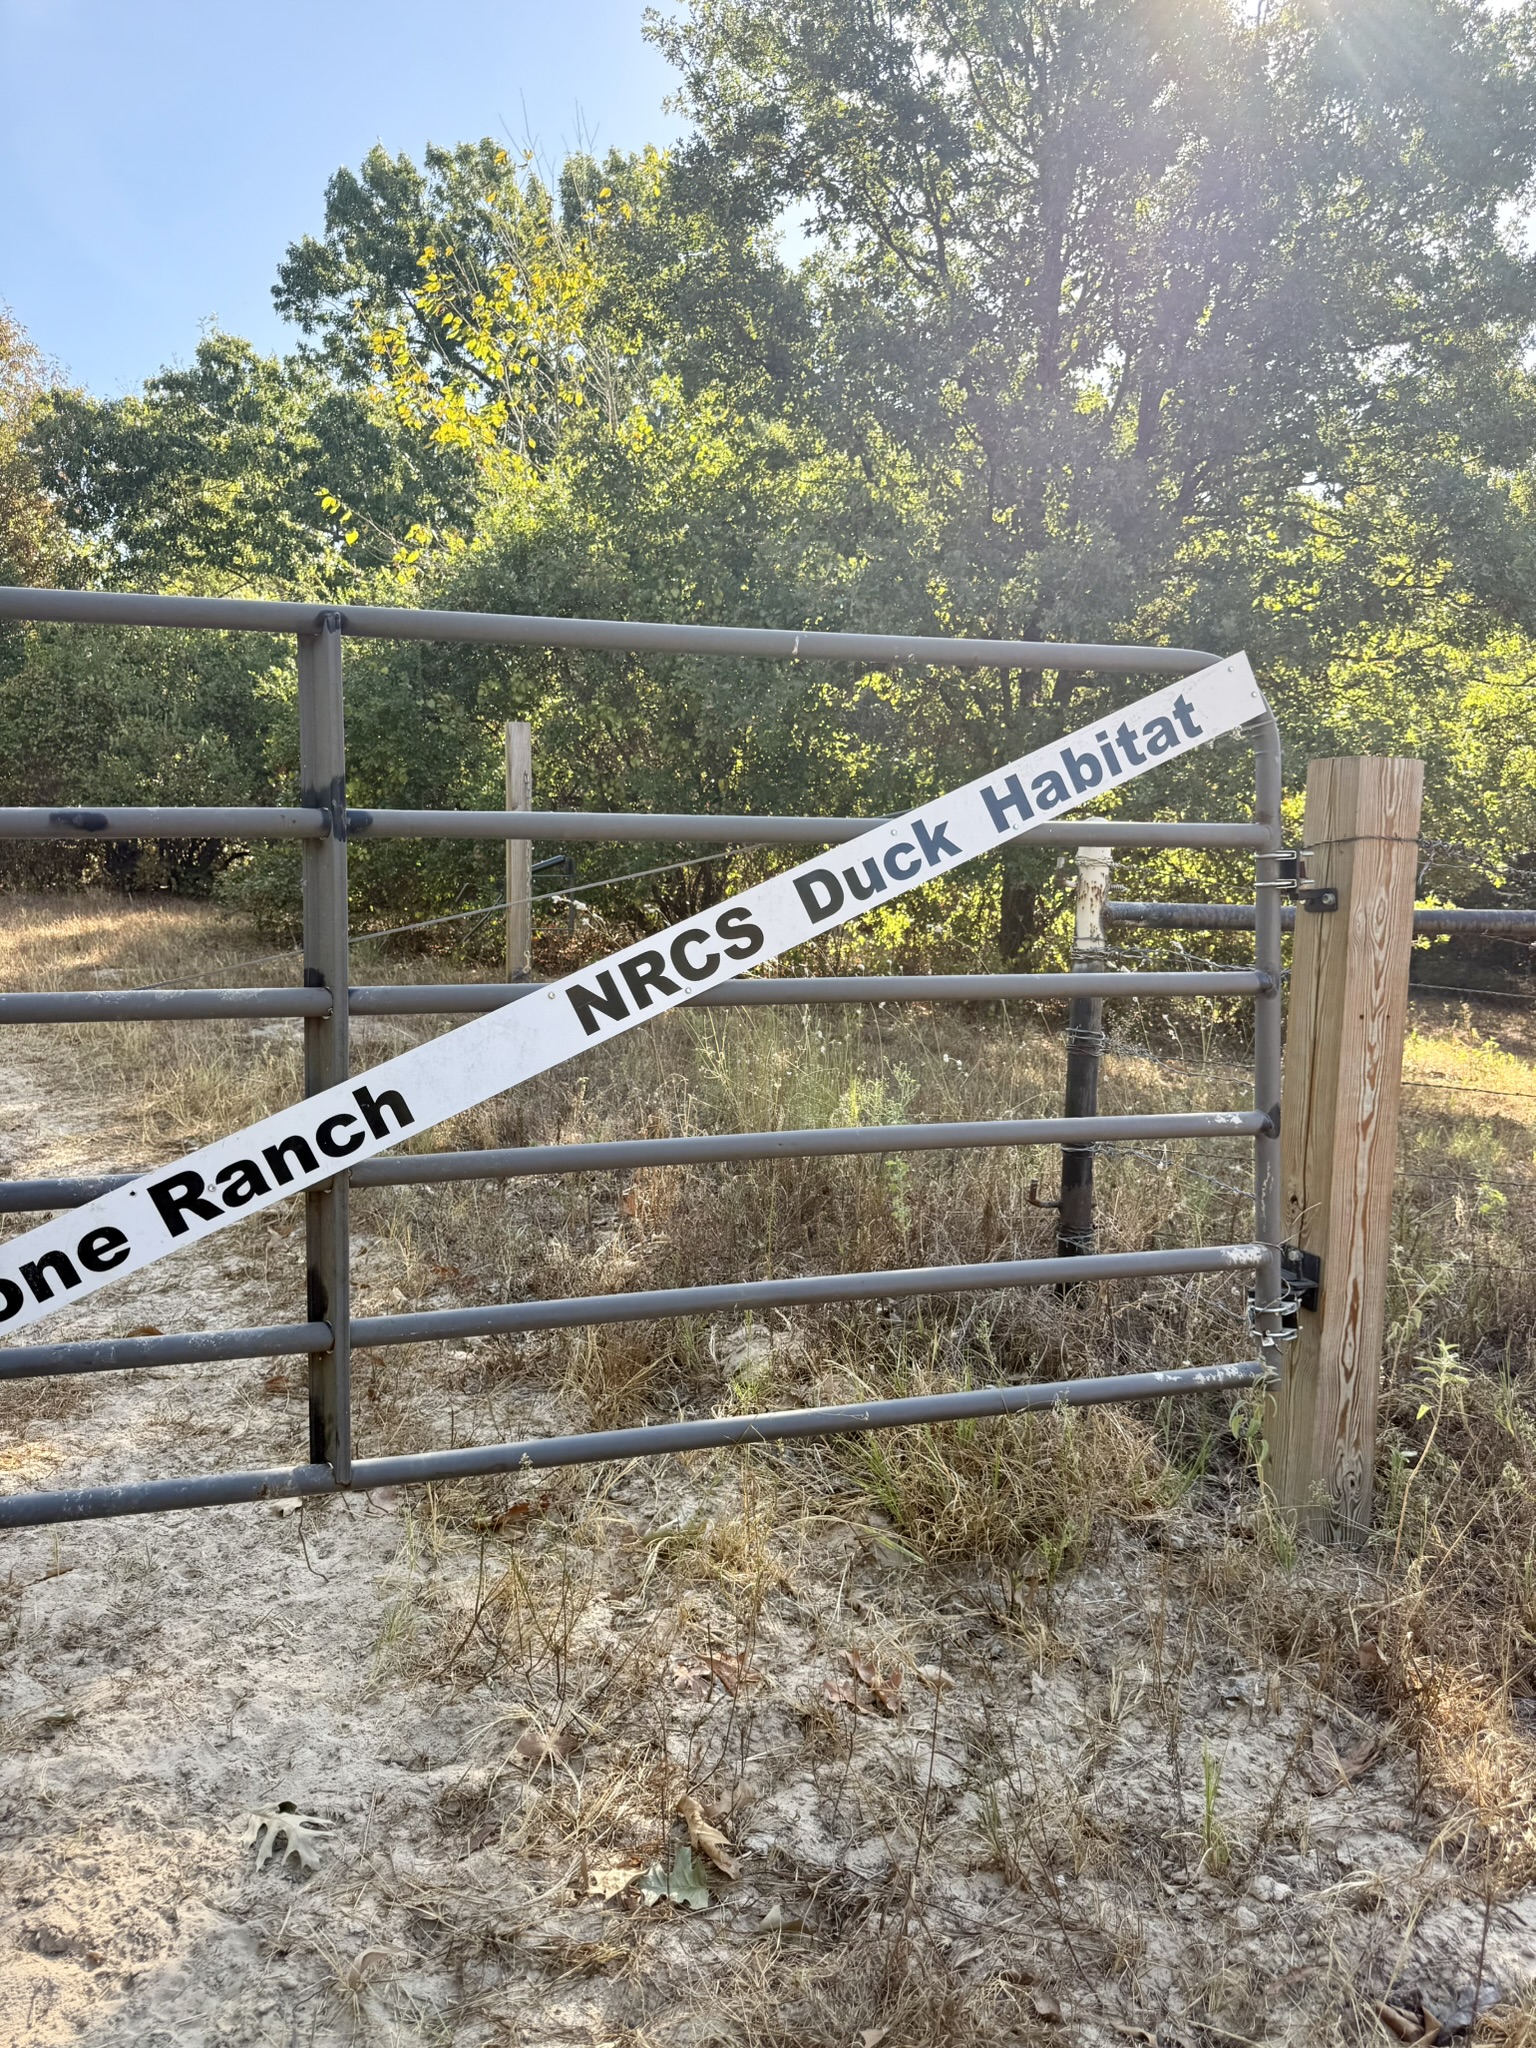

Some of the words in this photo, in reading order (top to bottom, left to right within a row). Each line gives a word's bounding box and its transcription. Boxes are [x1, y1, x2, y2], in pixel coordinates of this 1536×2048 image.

[147, 1085, 416, 1239] Ranch
[565, 906, 766, 1037] NRCS
[792, 818, 963, 925] Duck
[979, 693, 1204, 834] Habitat
